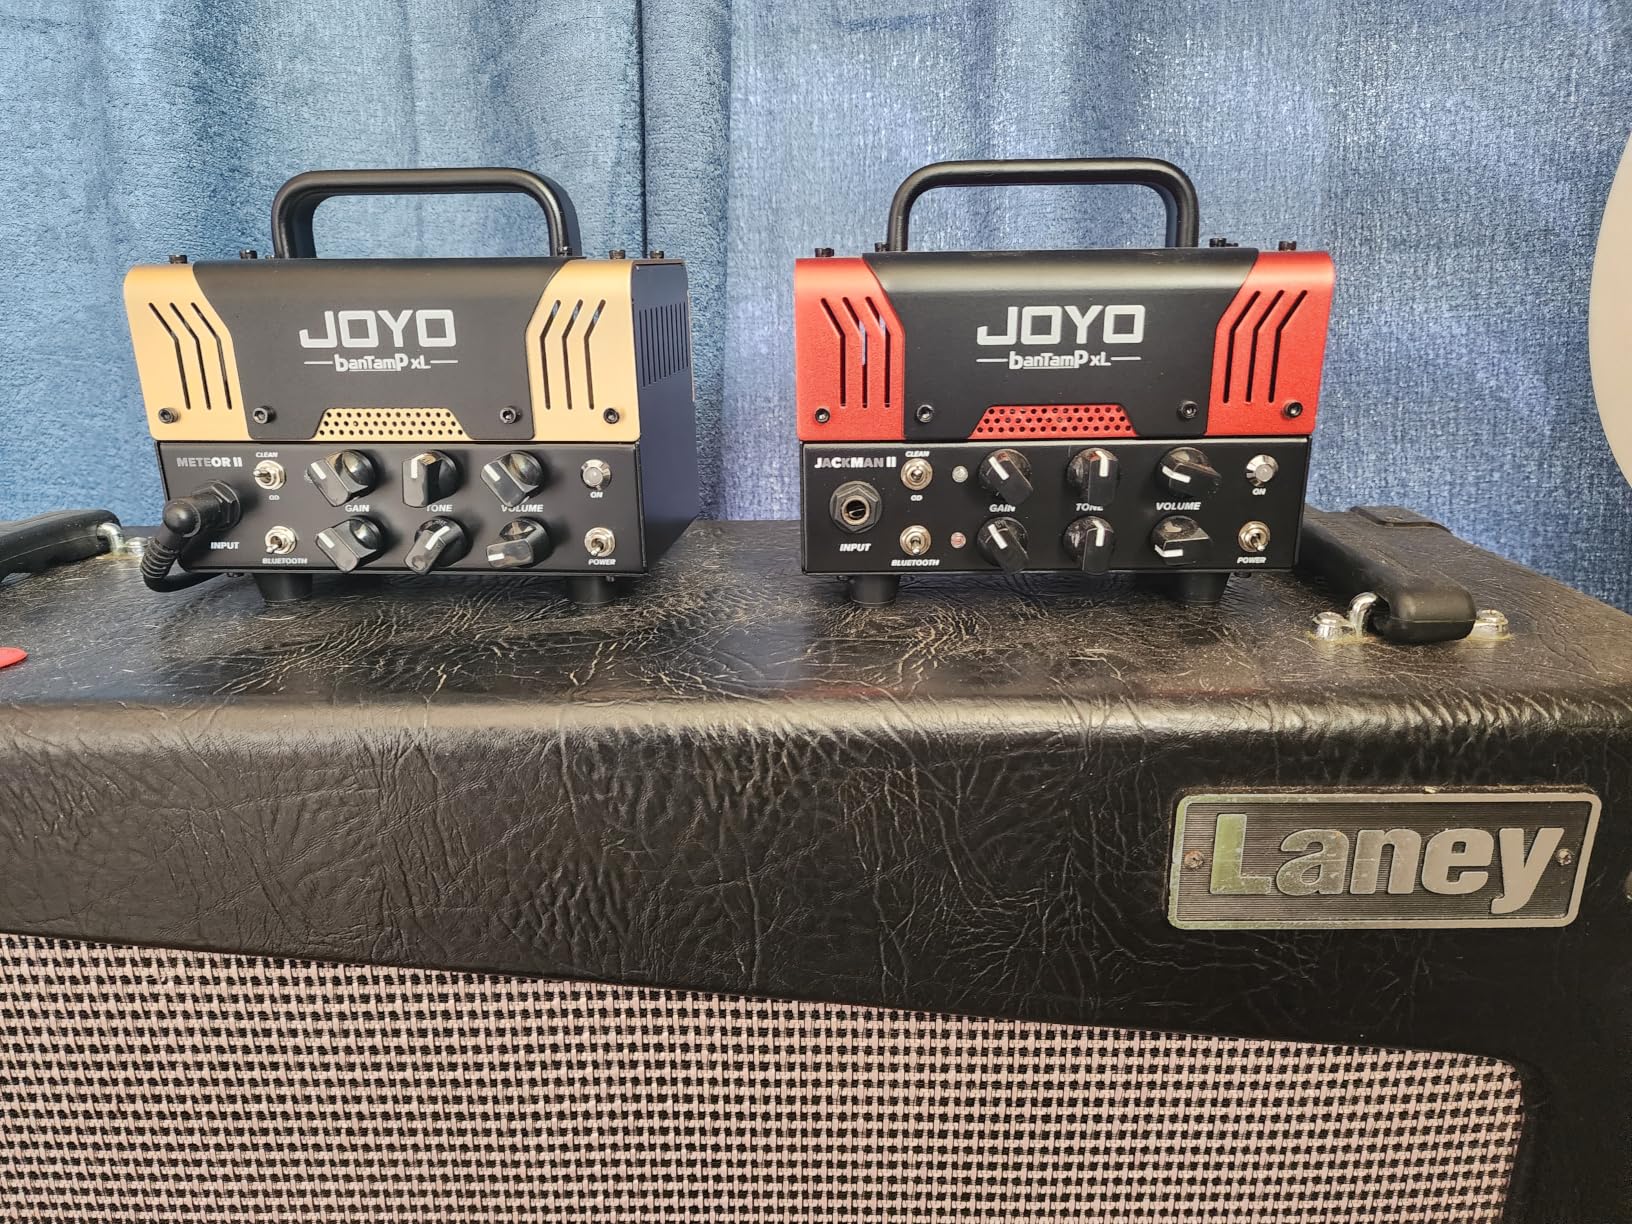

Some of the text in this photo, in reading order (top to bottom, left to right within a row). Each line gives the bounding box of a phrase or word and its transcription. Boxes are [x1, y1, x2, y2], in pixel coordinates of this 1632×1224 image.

[299, 309, 457, 348] JOYO
[975, 305, 1146, 346] JOYO
[176, 456, 243, 468] METEOR II
[814, 456, 897, 469] JACKMAN II
[589, 491, 604, 499] ON
[1252, 488, 1267, 496] ON
[344, 504, 370, 513] GAIN
[426, 504, 453, 513] TONE
[500, 504, 544, 513] VOLUME
[989, 503, 1016, 513] GAIN
[1155, 501, 1202, 511] VOLUME
[210, 541, 240, 550] INPUT
[839, 543, 872, 552] INPUT
[262, 557, 308, 565] BLUETOOTH
[588, 558, 616, 566] POWER
[890, 559, 940, 567] BLUETOOTH
[1236, 556, 1267, 564] POWER
[1209, 813, 1565, 914] Laney
